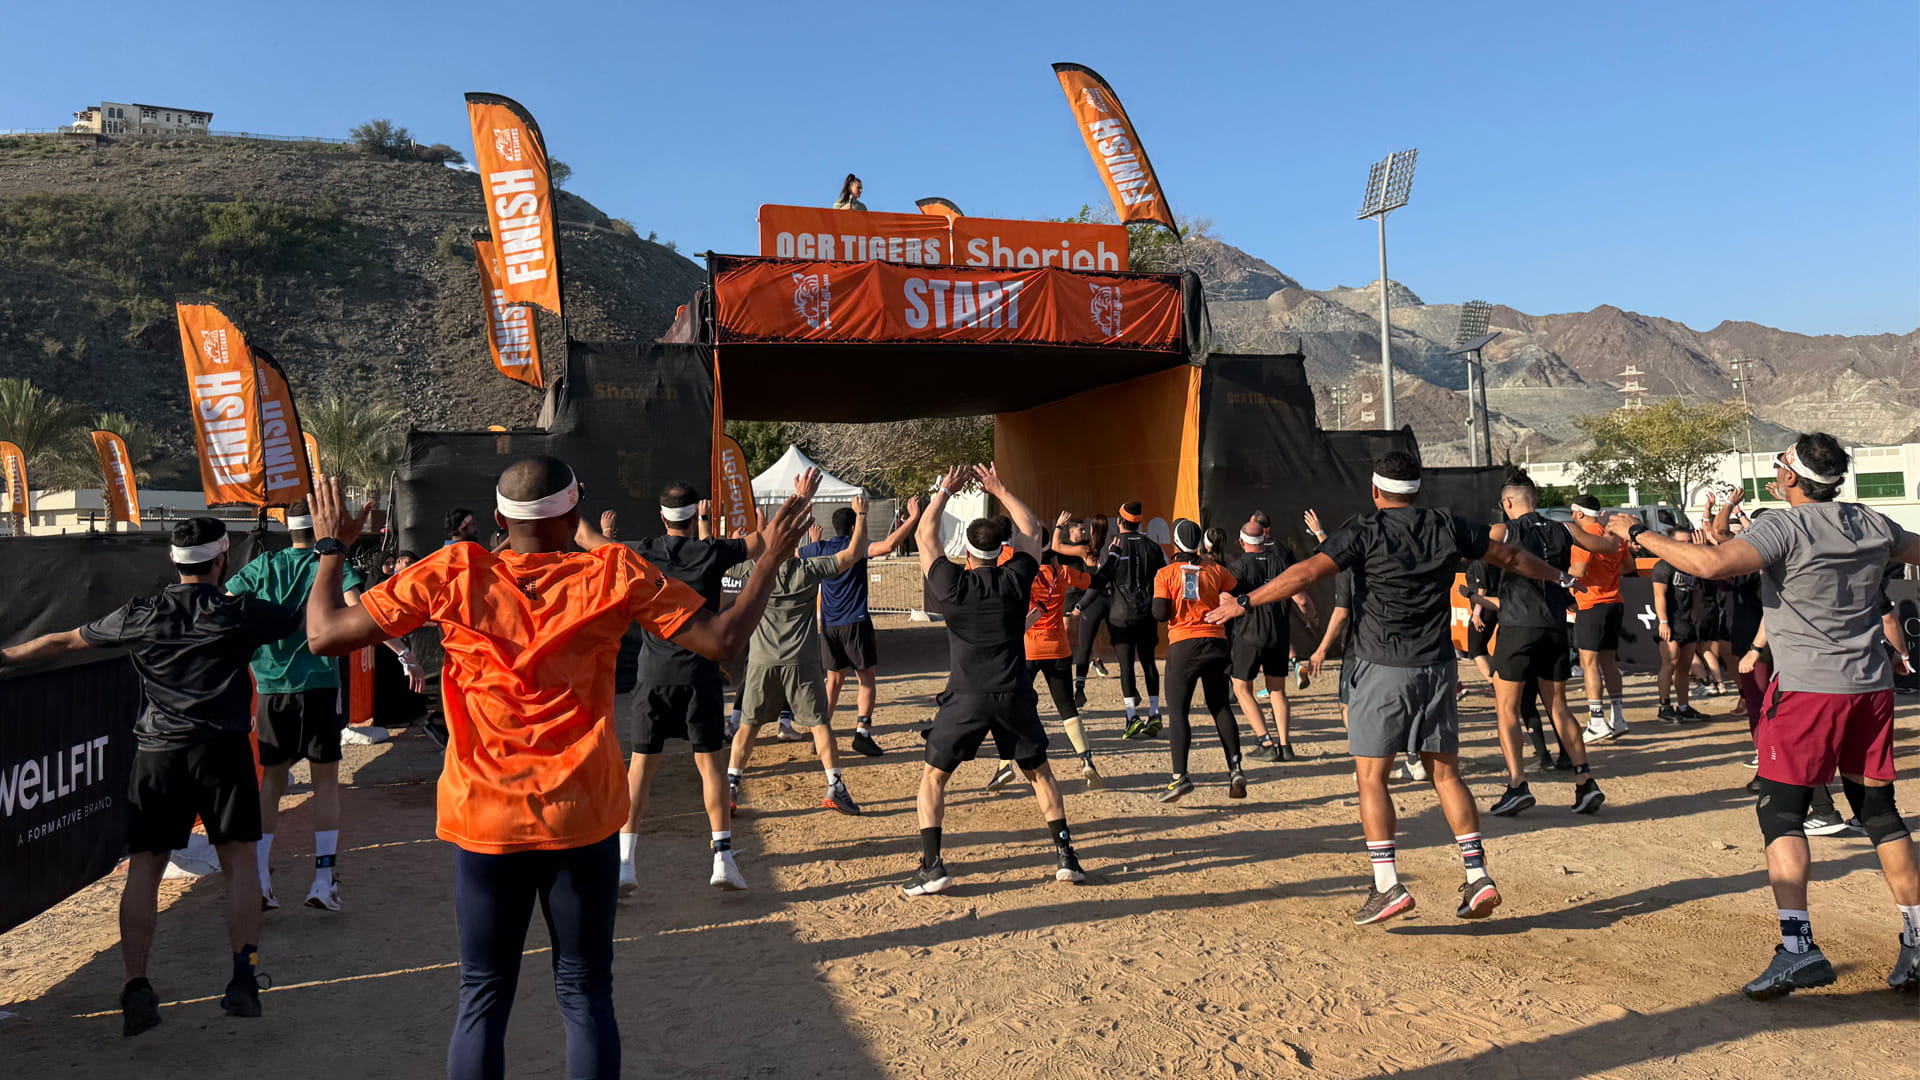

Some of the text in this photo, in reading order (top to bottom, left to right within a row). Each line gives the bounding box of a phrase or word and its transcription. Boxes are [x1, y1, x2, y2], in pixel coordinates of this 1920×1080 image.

[1089, 118, 1155, 206] FINISH
[490, 168, 547, 285] FINISH
[776, 232, 941, 265] OCR TIGERS
[904, 278, 1024, 329] START
[195, 371, 252, 486] FINISH
[17, 834, 24, 847] A
[84, 796, 113, 817] BRAND
